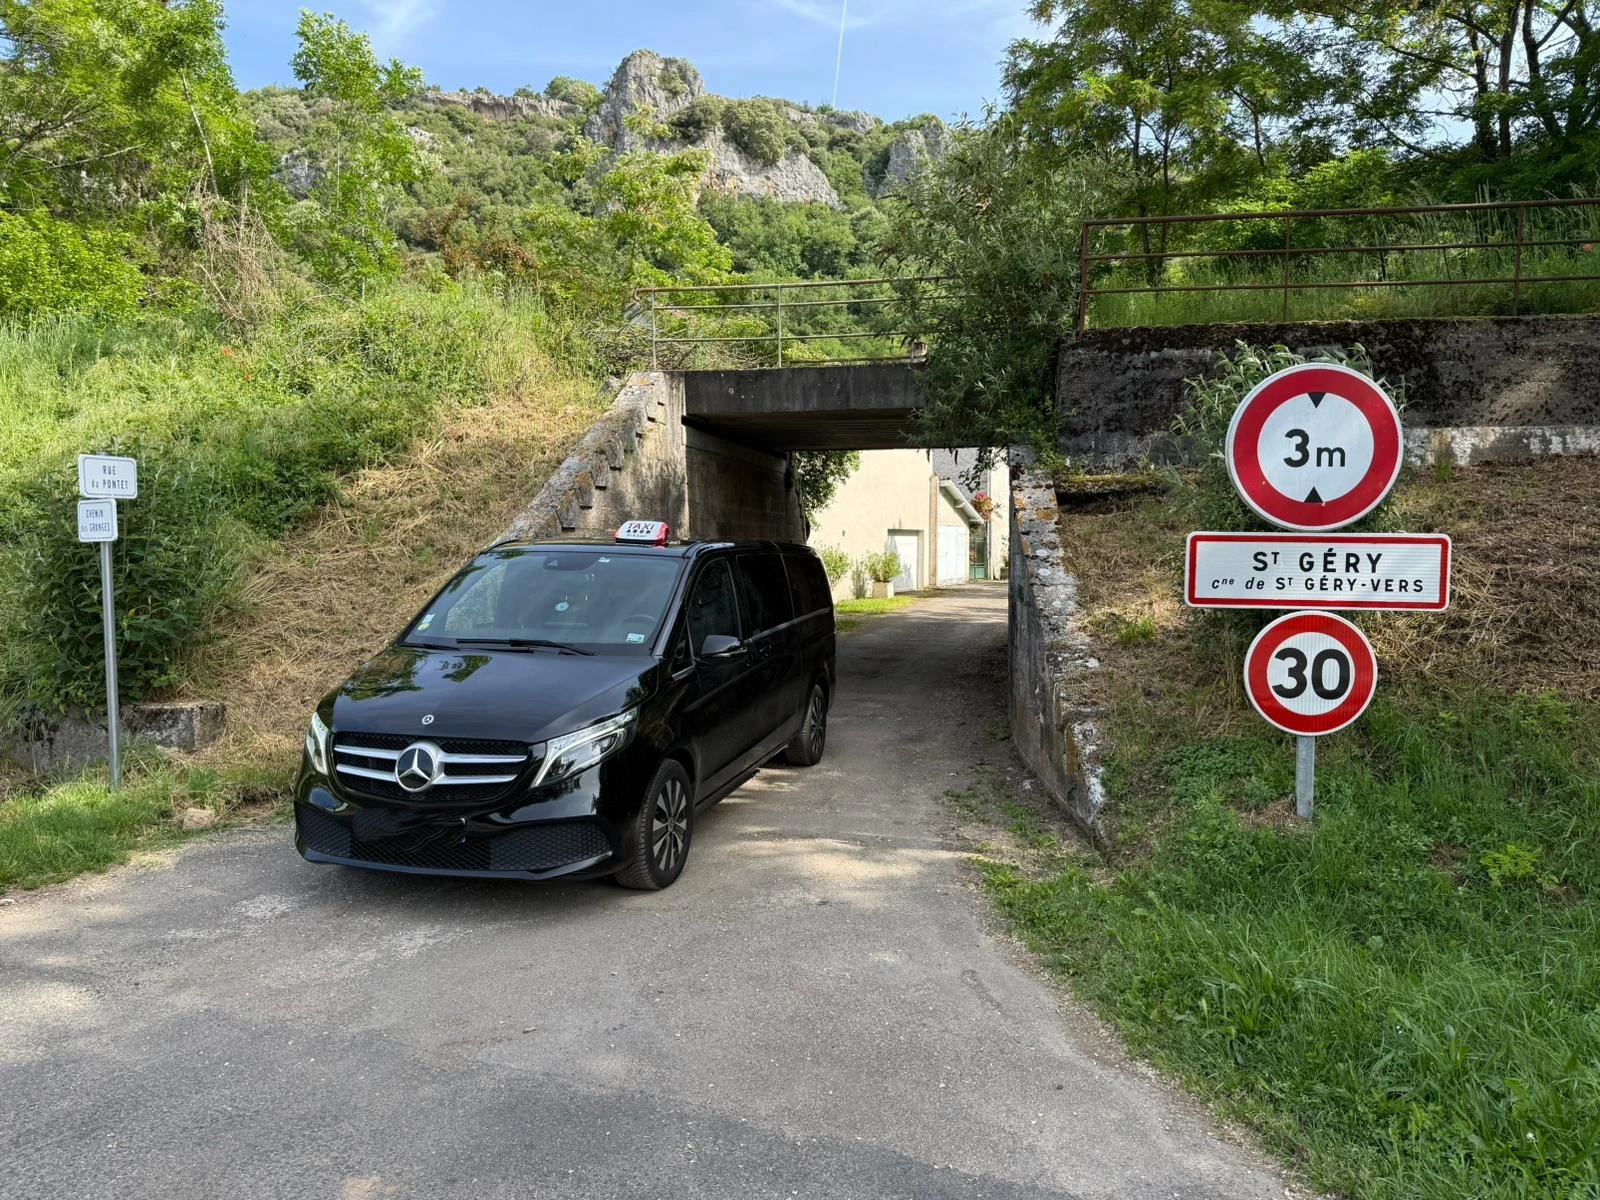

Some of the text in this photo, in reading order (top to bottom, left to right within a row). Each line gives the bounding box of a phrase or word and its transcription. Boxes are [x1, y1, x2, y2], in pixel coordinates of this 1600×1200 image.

[103, 465, 116, 475] RUE
[103, 480, 128, 490] PONTET
[86, 509, 103, 518] CHEMIN
[628, 522, 655, 530] TAXI
[1299, 548, 1382, 573] GÉRY
[1245, 577, 1265, 590] de
[1304, 575, 1424, 593] GÉRY-VERS
[1272, 647, 1350, 700] 30
